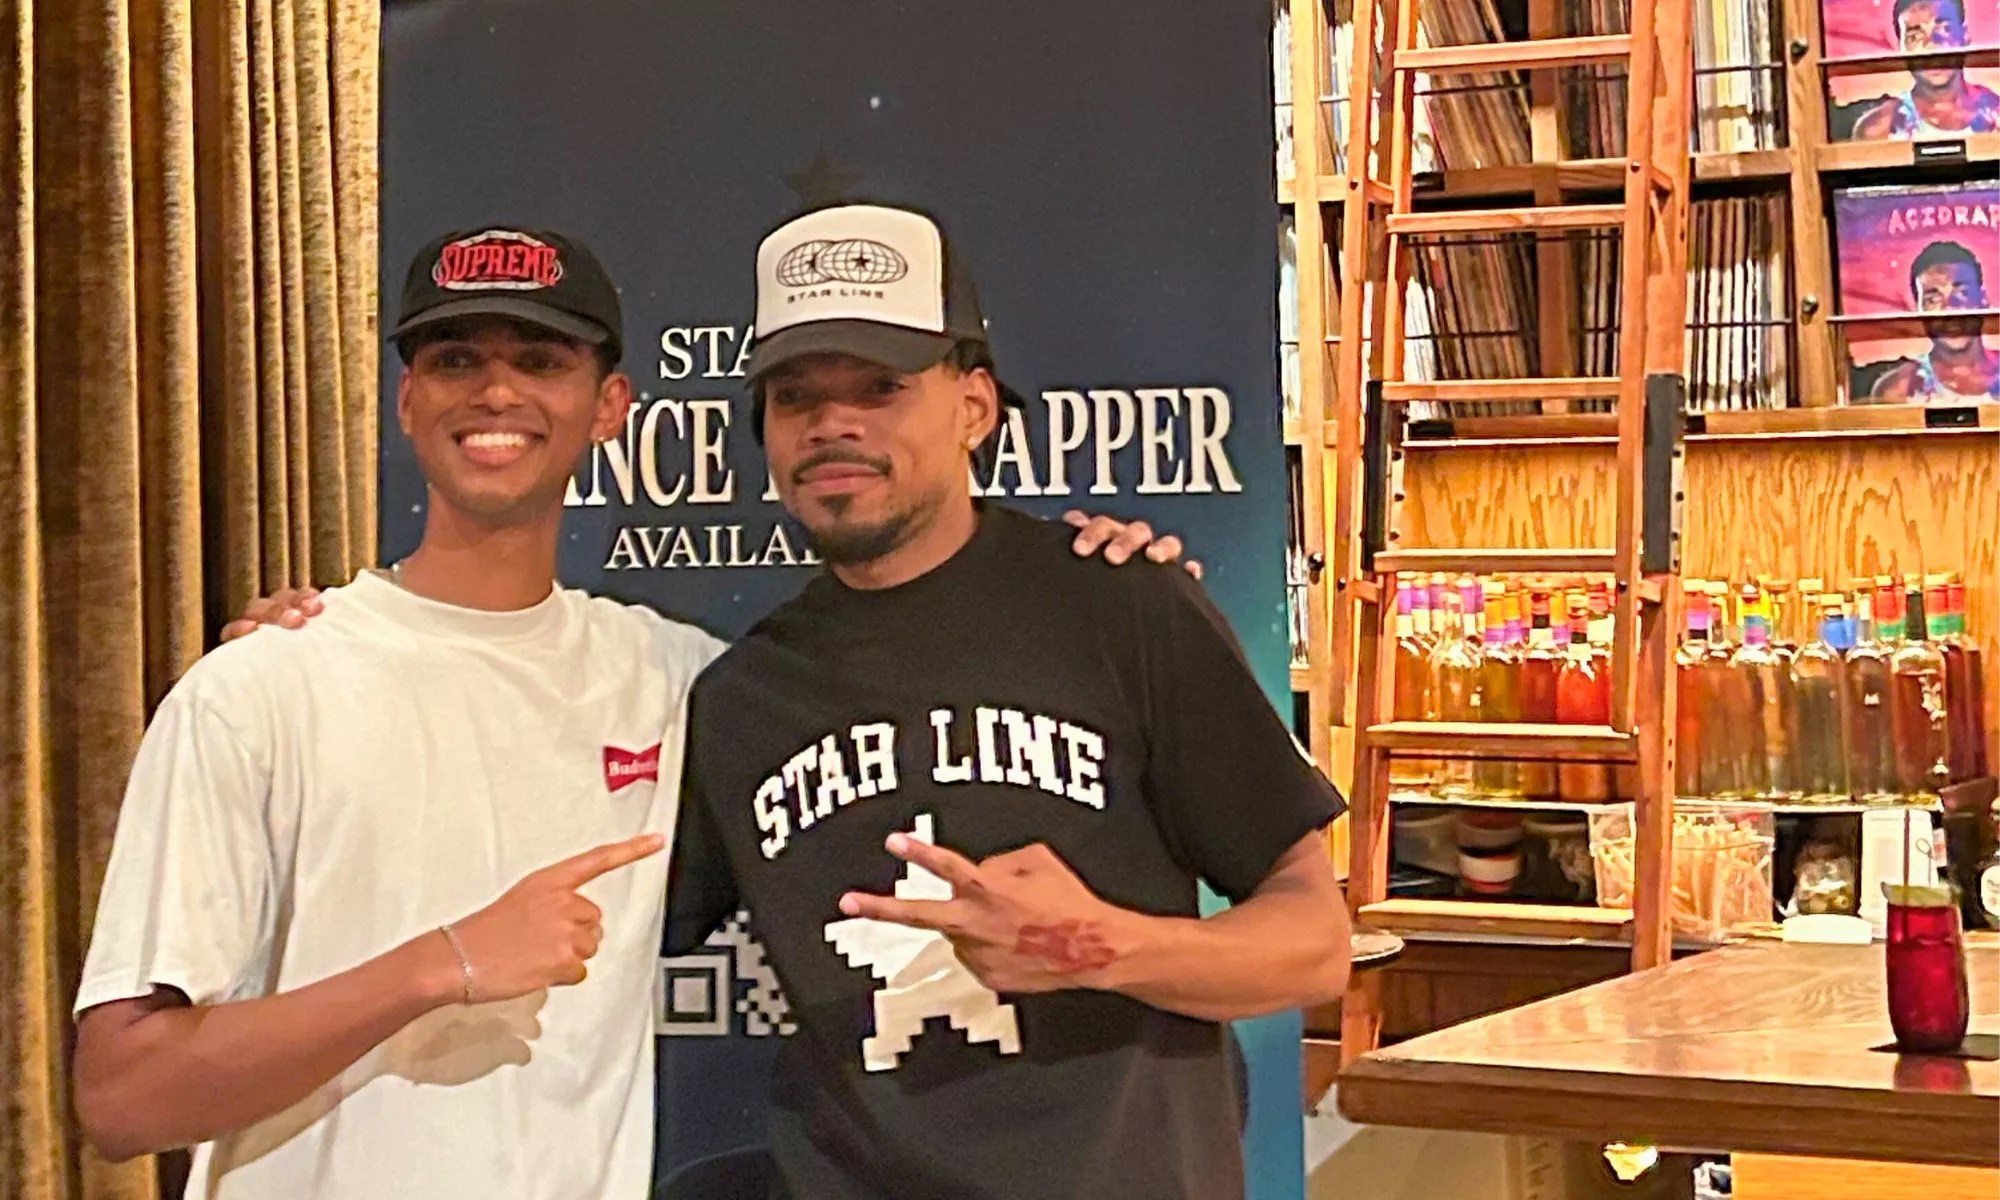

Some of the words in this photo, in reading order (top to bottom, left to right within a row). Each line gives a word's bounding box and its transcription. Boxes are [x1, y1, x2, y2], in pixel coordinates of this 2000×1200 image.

[436, 243, 557, 287] SUPREME
[787, 288, 832, 304] STAR
[839, 288, 884, 299] LINE
[562, 398, 734, 507] NCE
[967, 386, 1243, 498] APPER
[603, 523, 824, 570] AVAILA
[753, 722, 898, 860] STAR
[929, 706, 1106, 810] LINE
